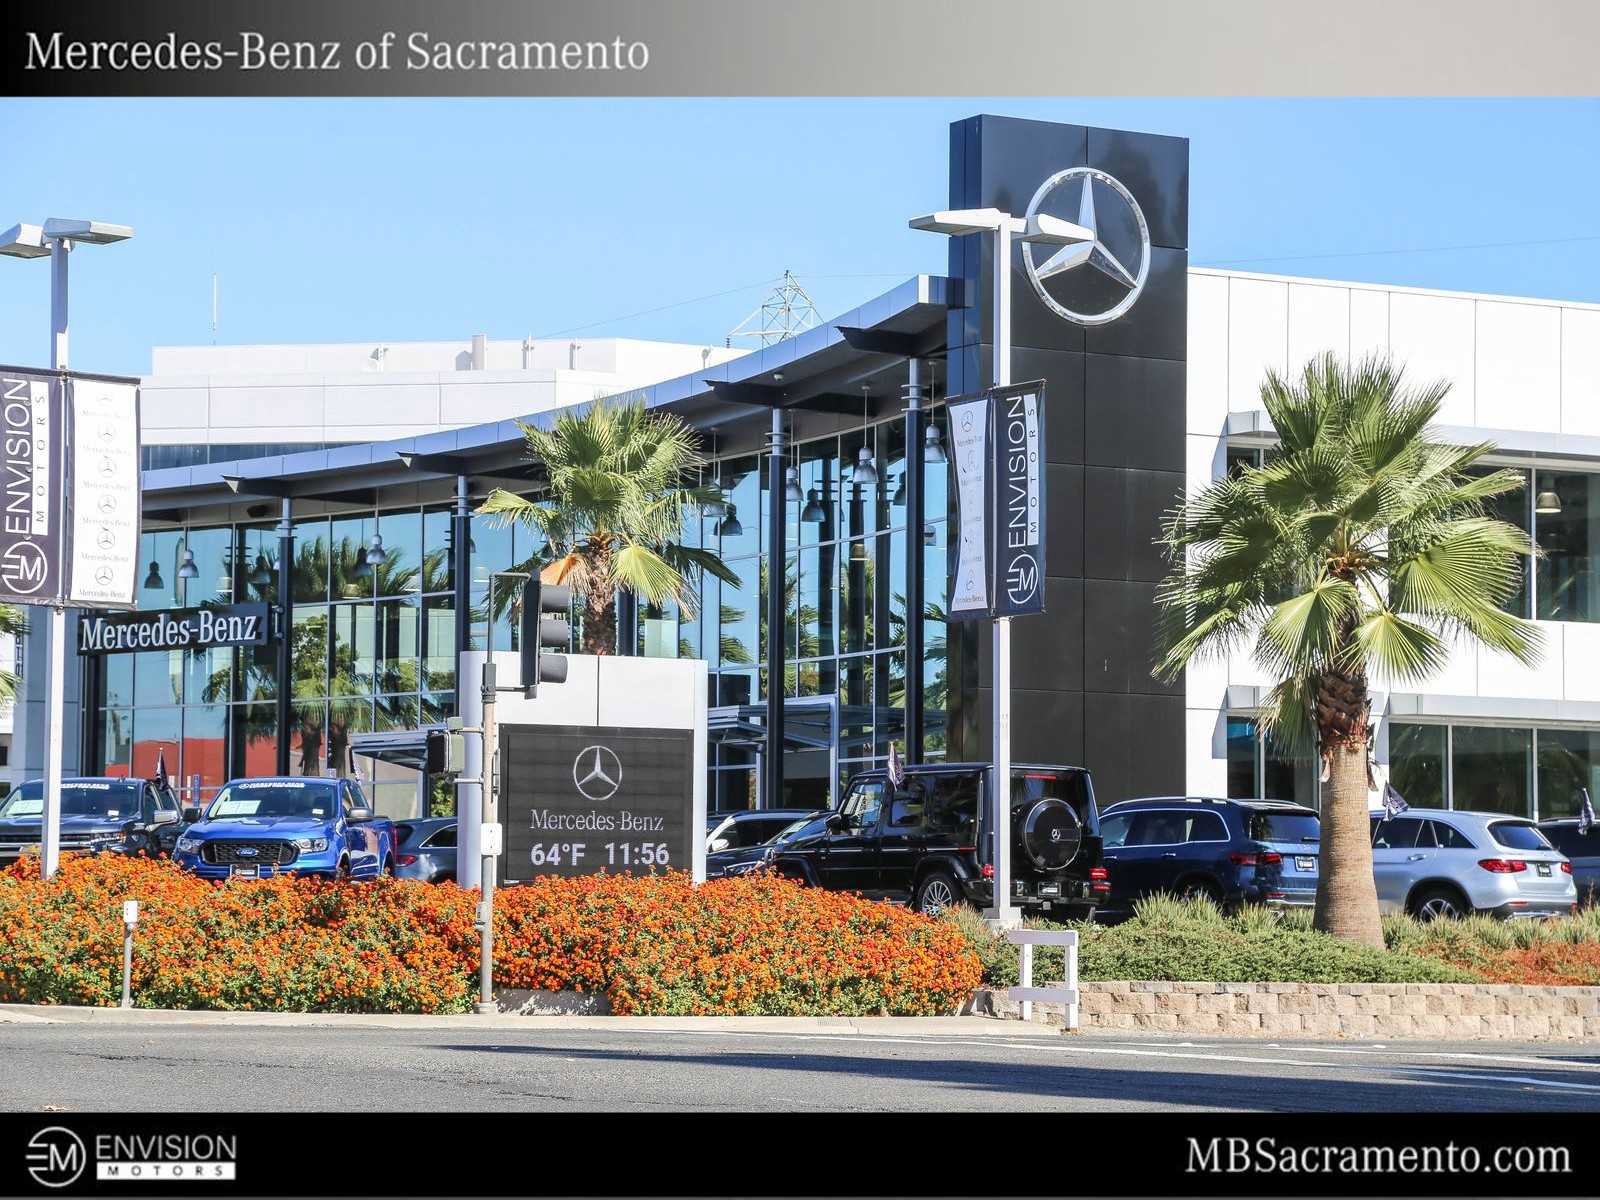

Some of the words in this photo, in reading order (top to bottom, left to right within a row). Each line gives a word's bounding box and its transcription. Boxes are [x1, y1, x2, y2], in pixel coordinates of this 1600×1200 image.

[3, 378, 31, 535] ENVISION
[36, 395, 46, 523] MOTORS
[1006, 395, 1027, 548] ENVISION
[1028, 407, 1038, 533] MOTORS
[79, 609, 258, 651] Mercedes-Benz
[529, 808, 664, 832] Mercedes-Benz
[530, 842, 586, 866] 64°F
[604, 842, 670, 866] 11:56
